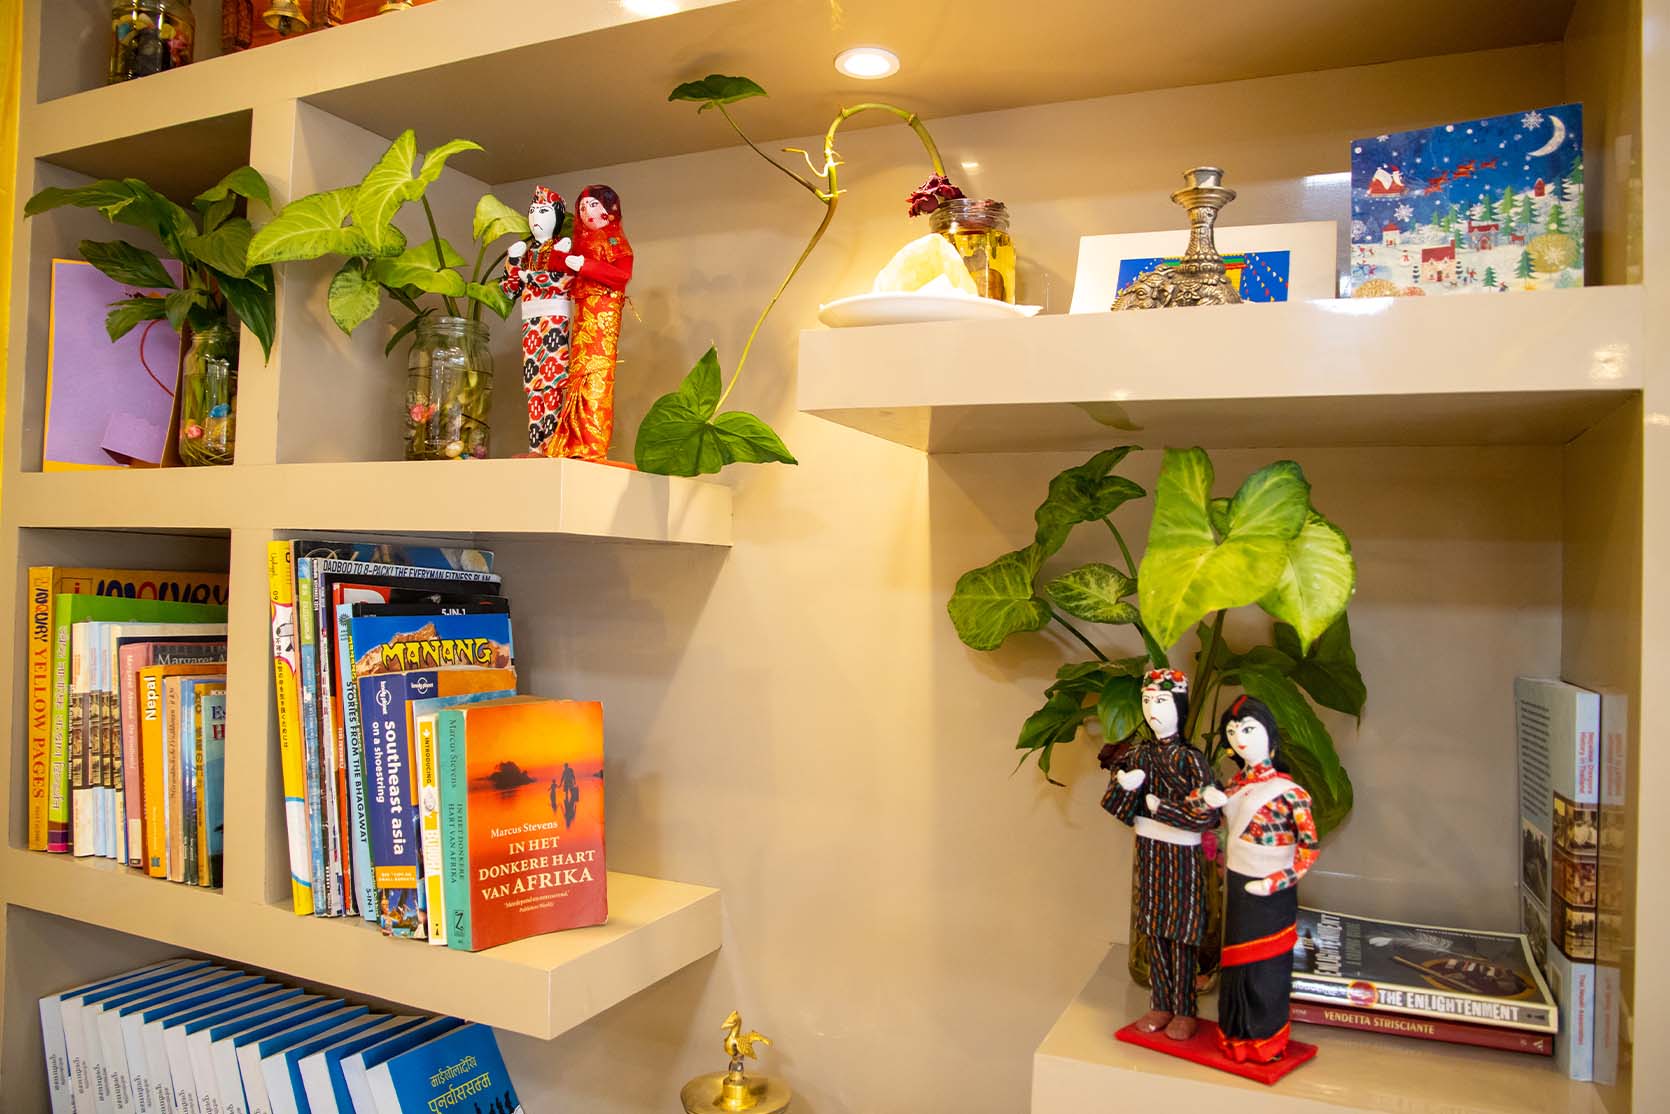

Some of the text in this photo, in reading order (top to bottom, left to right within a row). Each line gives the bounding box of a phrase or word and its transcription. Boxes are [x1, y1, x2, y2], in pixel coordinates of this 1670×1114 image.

[353, 562, 364, 574] TO
[394, 566, 408, 577] THE
[380, 637, 492, 672] MANANG
[33, 648, 48, 731] YELLOW
[144, 675, 160, 721] Nepal
[32, 737, 47, 799] PAGES
[346, 681, 368, 844] STORIES FROM THE BHAGAWAT
[372, 721, 385, 804] on a shoestring
[424, 737, 432, 784] INTRODUCING
[448, 719, 458, 788] Marcus Stevens
[384, 720, 406, 856] southeast asia
[490, 821, 558, 839] Marcus Stevens
[508, 836, 560, 855] IN HET
[478, 849, 596, 881] DONKERE HART
[366, 888, 374, 913] 5-IN-1
[481, 867, 594, 901] VAN AFRIKA
[1323, 1010, 1371, 1026] VENDETTA
[1373, 1016, 1435, 1035] STRISCIANTE
[1379, 990, 1404, 1005] THE
[1406, 992, 1519, 1021] ENLIGHTENMENT
